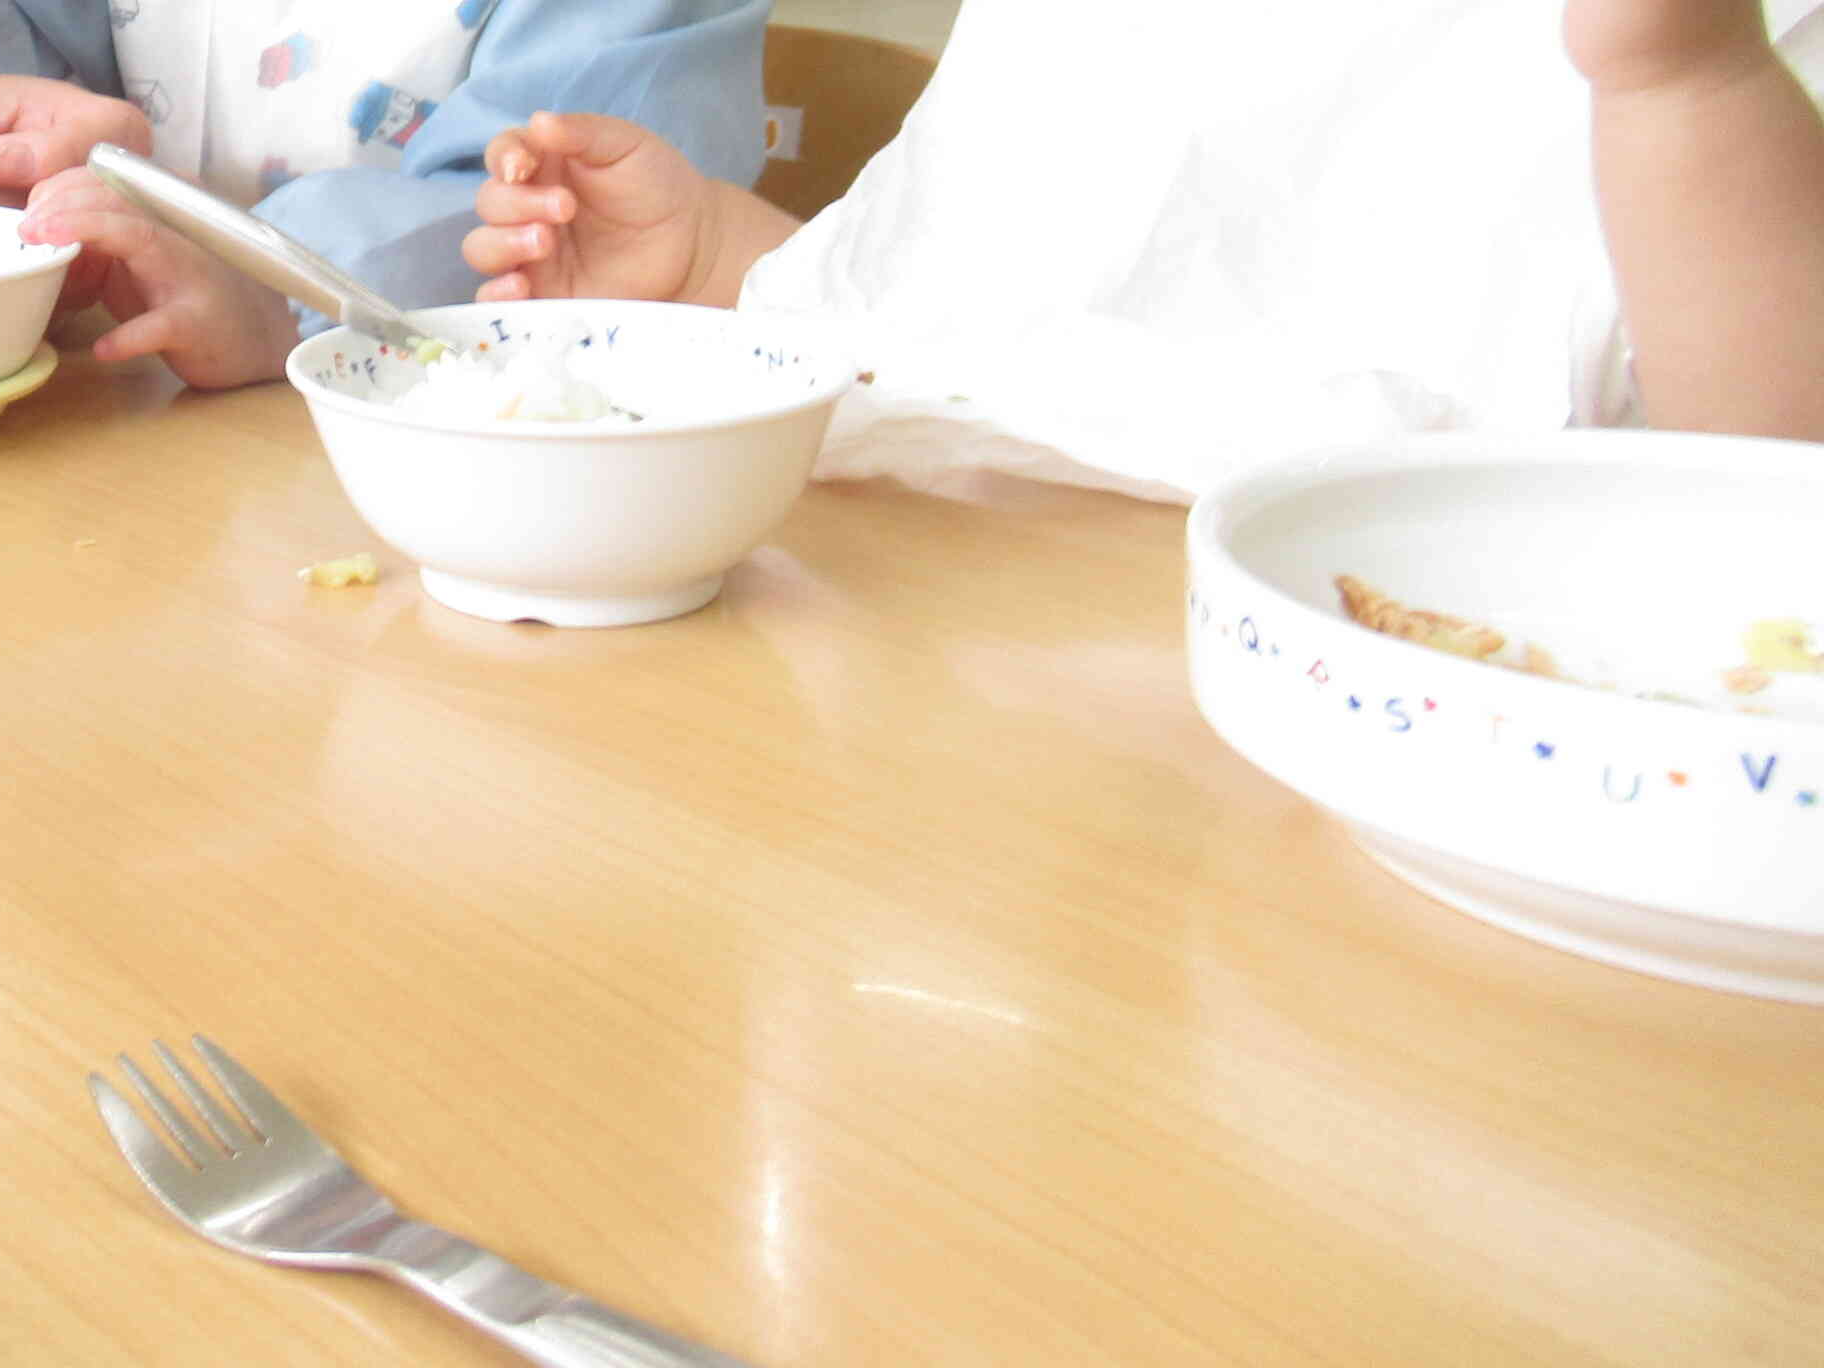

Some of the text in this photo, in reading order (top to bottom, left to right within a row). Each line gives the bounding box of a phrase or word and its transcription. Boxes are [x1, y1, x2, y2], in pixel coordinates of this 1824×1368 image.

[490, 319, 510, 342] I
[1238, 616, 1262, 654] Q
[1385, 697, 1412, 732] S
[1602, 764, 1641, 802] U
[1739, 752, 1776, 792] V
